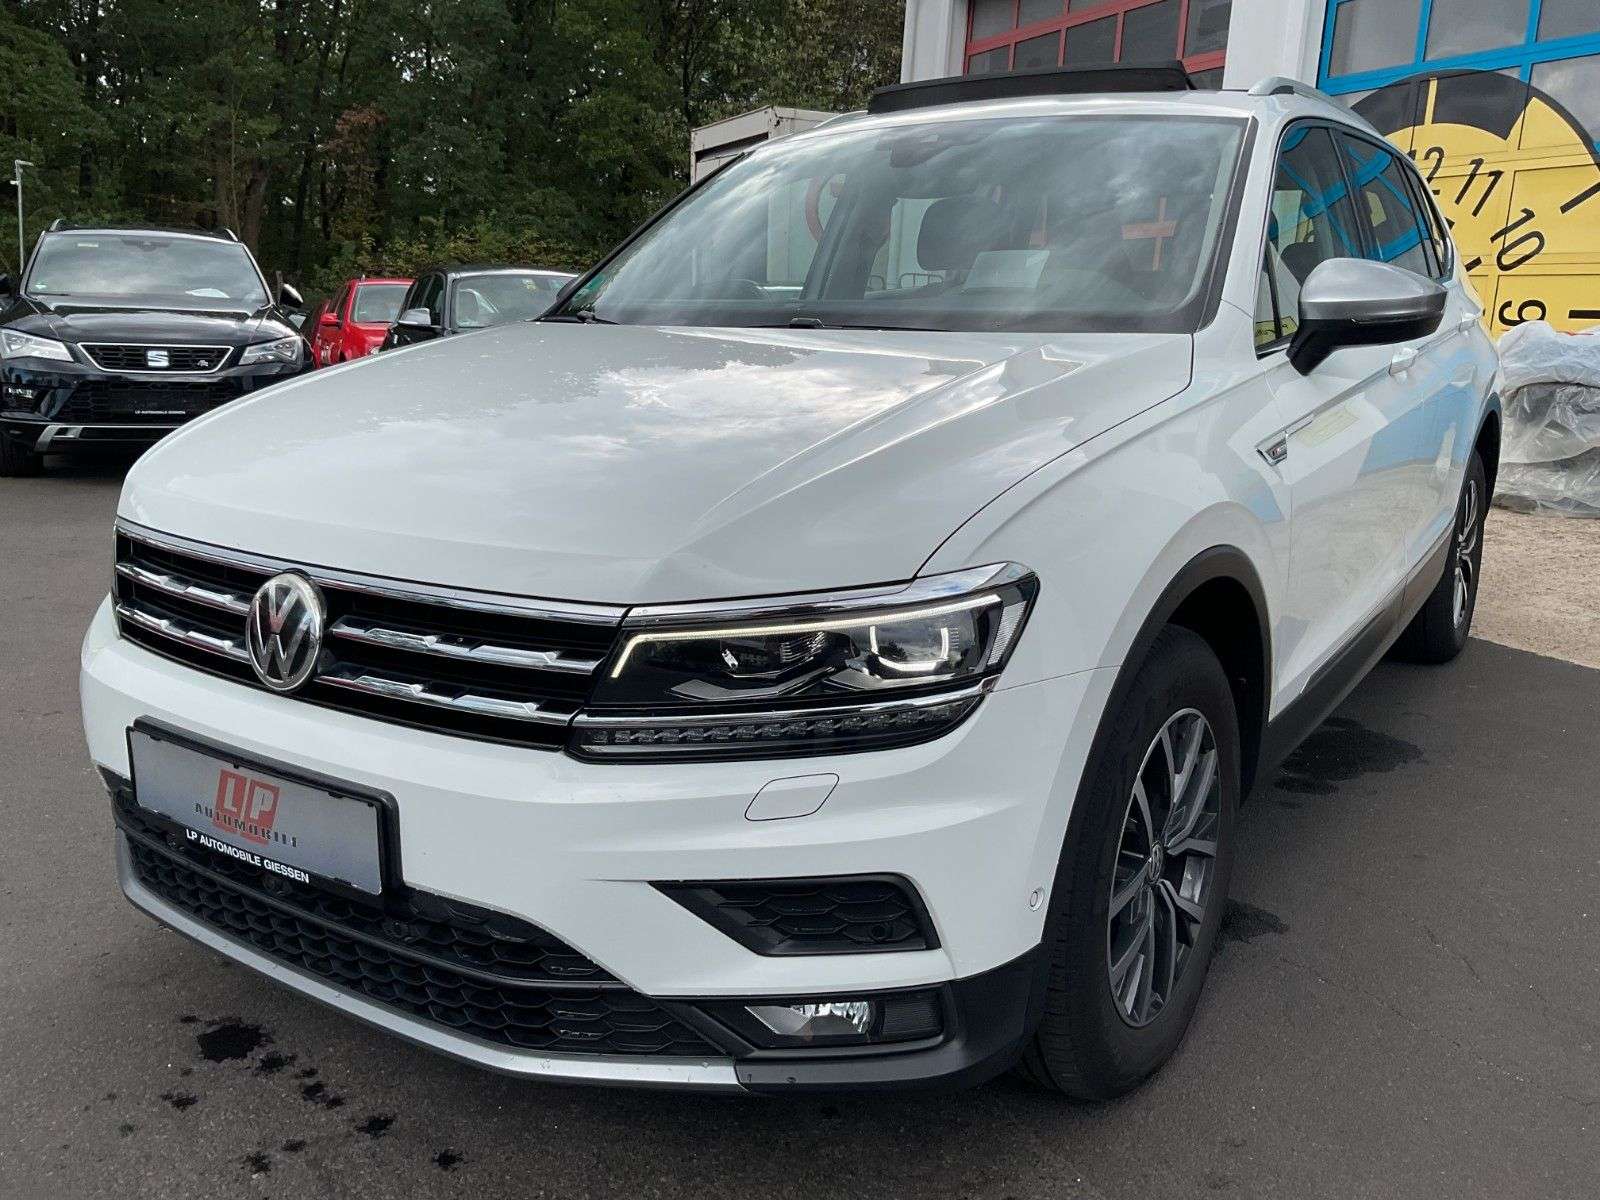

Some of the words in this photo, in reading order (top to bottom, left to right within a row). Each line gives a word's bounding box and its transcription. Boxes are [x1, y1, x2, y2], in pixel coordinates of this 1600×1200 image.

[1407, 147, 1445, 196] 2
[1455, 157, 1505, 218] 11
[1490, 207, 1545, 271] 10
[222, 777, 275, 820] LP
[186, 828, 198, 841] LP
[199, 835, 262, 867] AUTOMOBILE
[263, 859, 310, 884] GIESSEN
